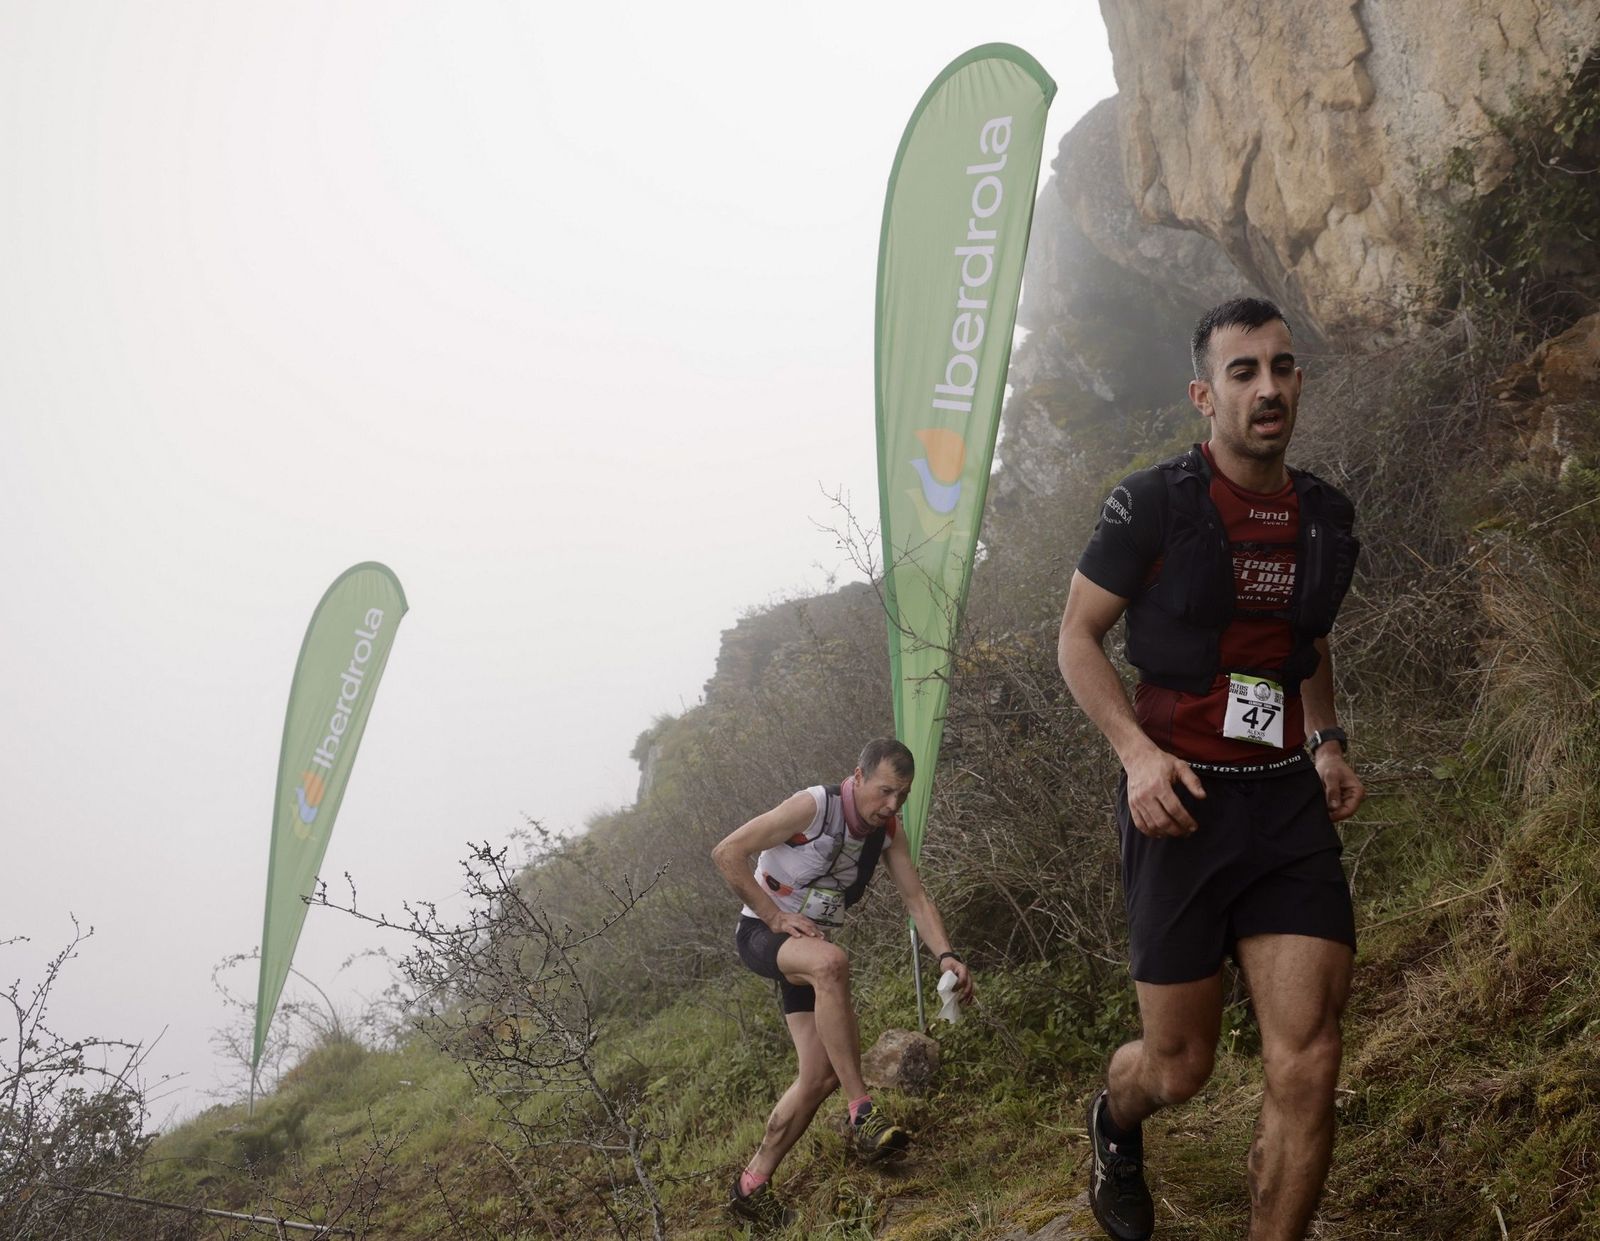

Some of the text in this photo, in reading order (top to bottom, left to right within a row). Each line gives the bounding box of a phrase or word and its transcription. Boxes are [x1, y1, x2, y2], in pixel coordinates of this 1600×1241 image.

[932, 115, 1013, 412] Iberdrola
[1249, 508, 1290, 521] land
[312, 607, 384, 769] Iberdrola
[1241, 707, 1276, 731] 47
[821, 906, 838, 917] 12
